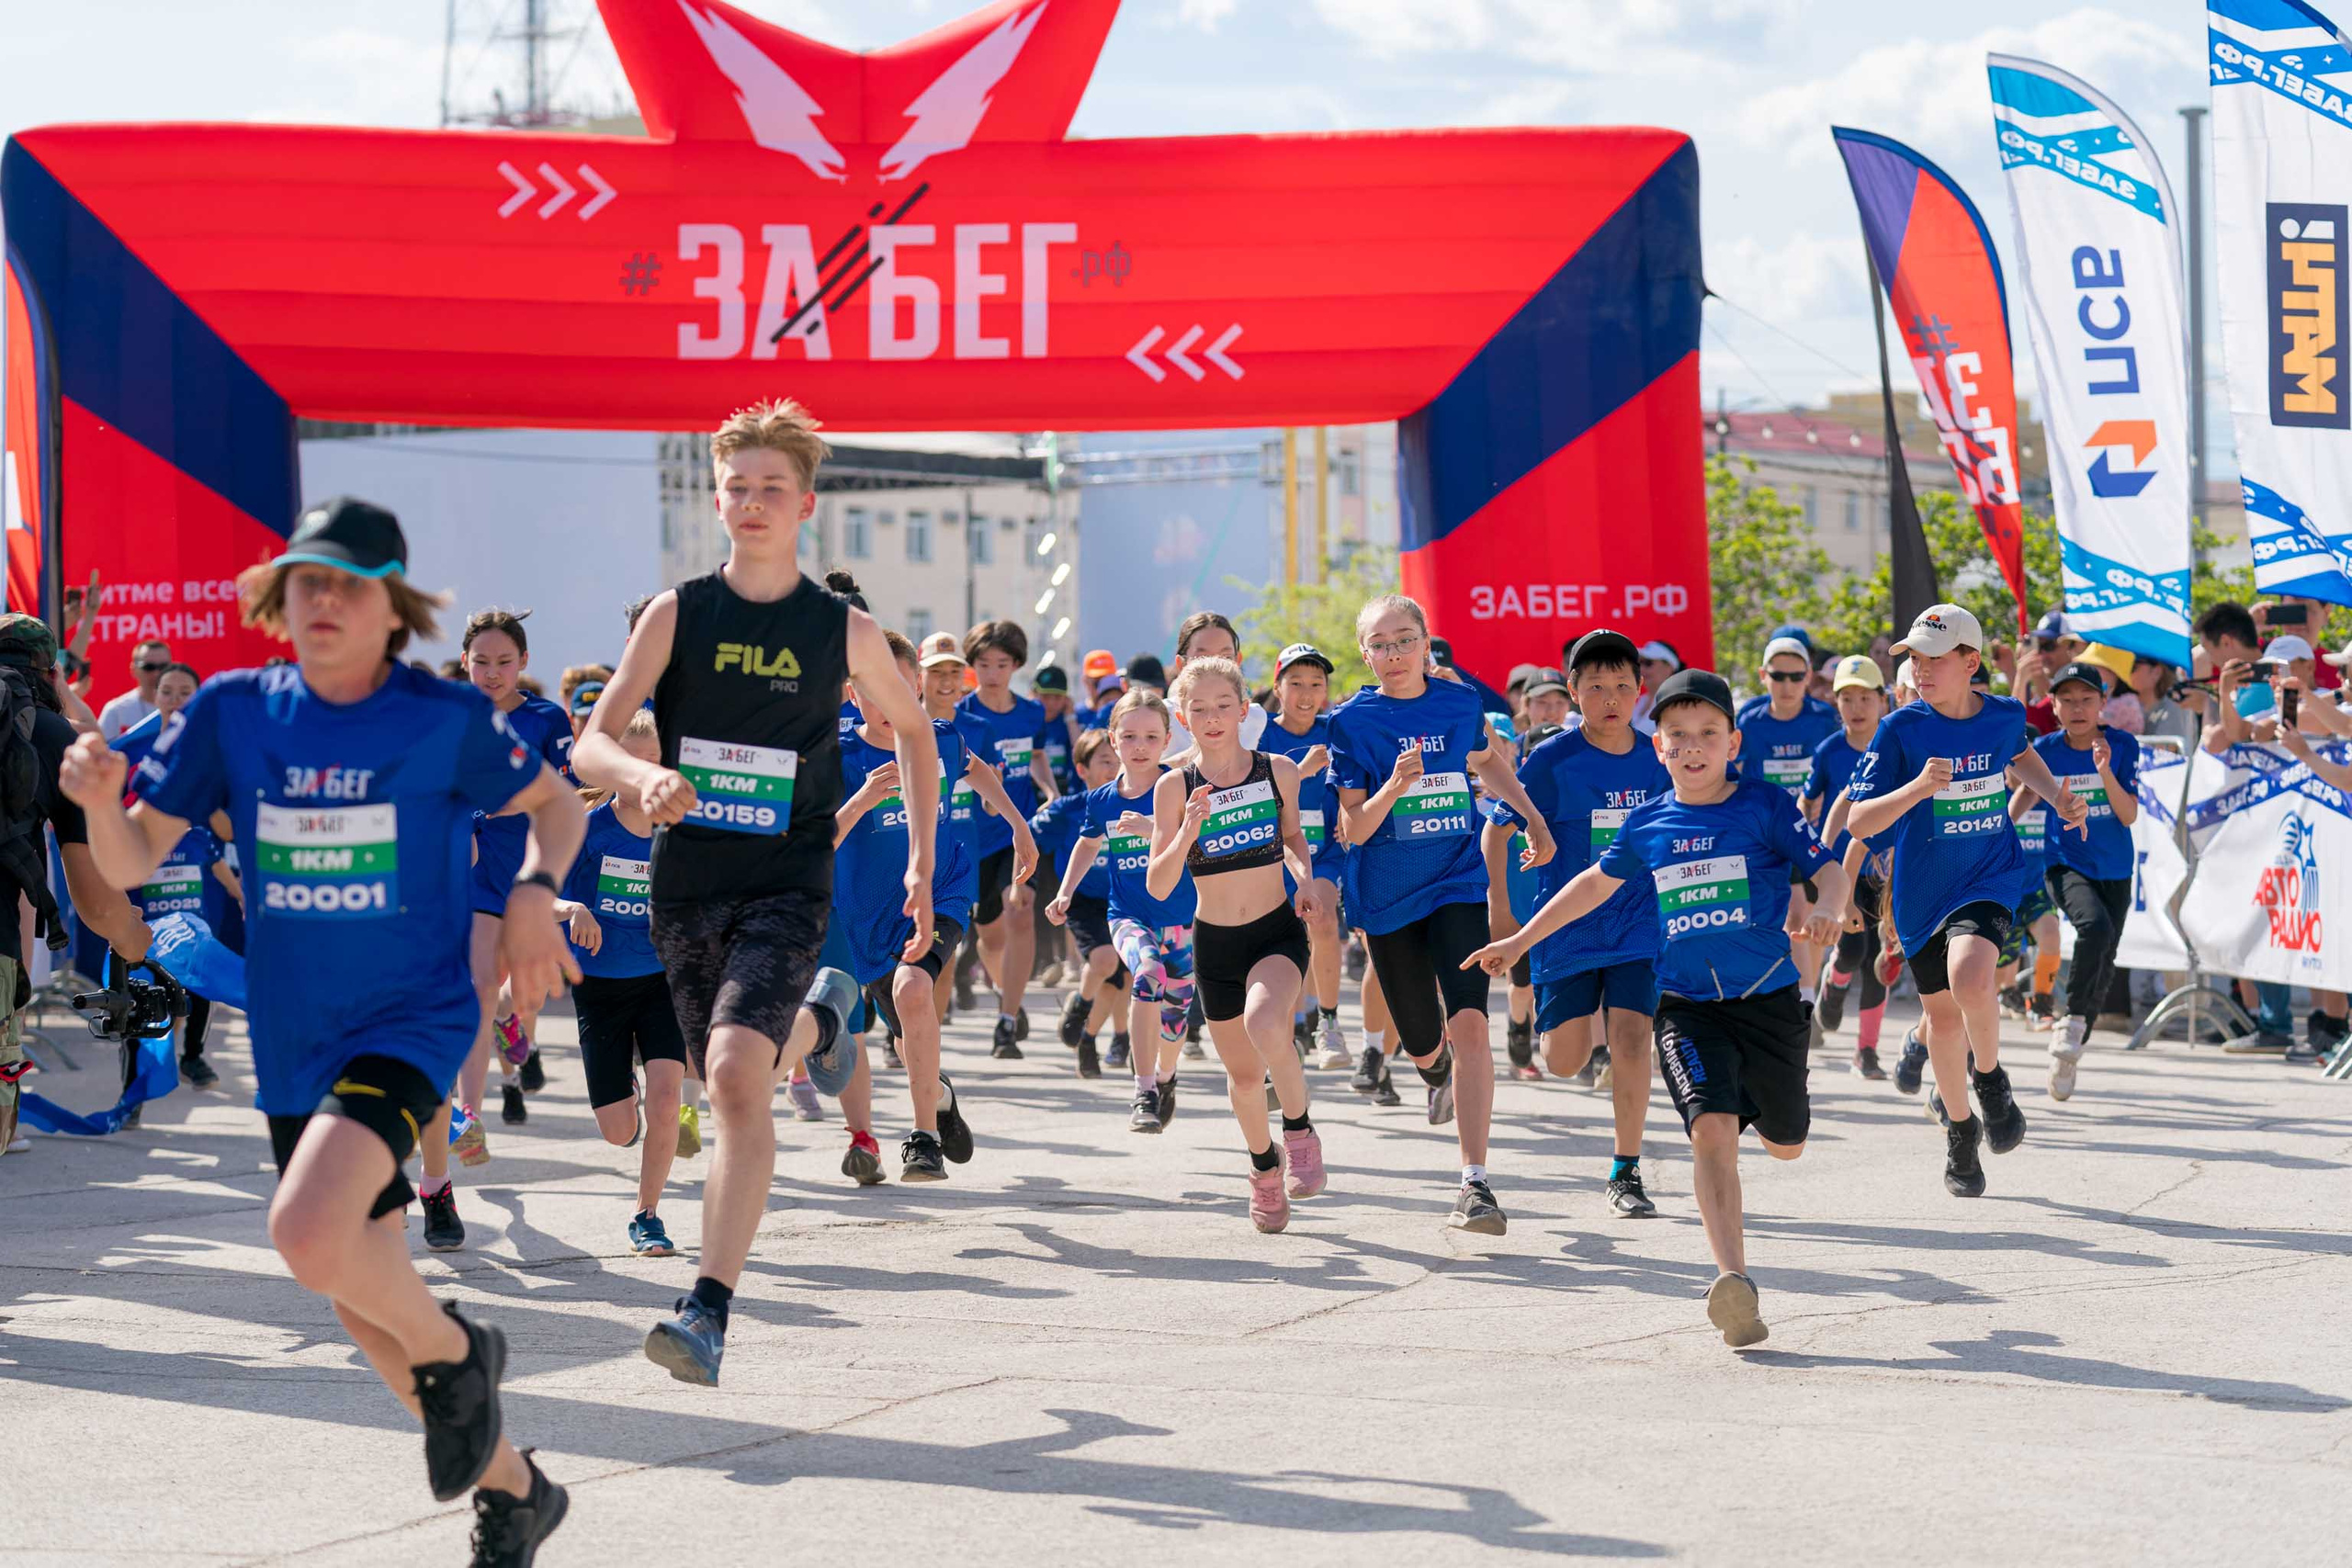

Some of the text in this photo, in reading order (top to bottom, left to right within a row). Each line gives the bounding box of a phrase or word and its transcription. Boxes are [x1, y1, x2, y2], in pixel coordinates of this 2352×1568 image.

[184, 580, 244, 602] все
[1471, 583, 1689, 619] ЗАБЕГ.РФ
[715, 642, 801, 678] FILA
[770, 680, 798, 693] PRO
[718, 747, 757, 764] ЗАБЕГ
[283, 764, 375, 799] ЗАБЕГ
[710, 773, 758, 794] 1КМ
[1421, 776, 1450, 788] ЗАБЕГ
[1962, 781, 1987, 794] ЗАБЕГ
[1216, 790, 1244, 806] ЗАБЕГ
[1419, 795, 1453, 808] 1КМ
[1606, 789, 1647, 808] ЗАБЕГ
[1959, 798, 1990, 812] 1КМ
[686, 798, 776, 827] 20159
[1218, 808, 1252, 826] 1КМ
[1411, 816, 1466, 834] 20111
[1944, 815, 2003, 834] 20147
[1204, 824, 1274, 852] 20062
[1672, 836, 1715, 853] ЗАБЕГ
[1679, 863, 1712, 879] ЗАБЕГ
[265, 882, 387, 911] 20001
[1679, 886, 1718, 904] 1КМ
[2251, 866, 2300, 908] АВТО
[1668, 907, 1747, 935] 20004
[2267, 910, 2323, 953] РАДИО
